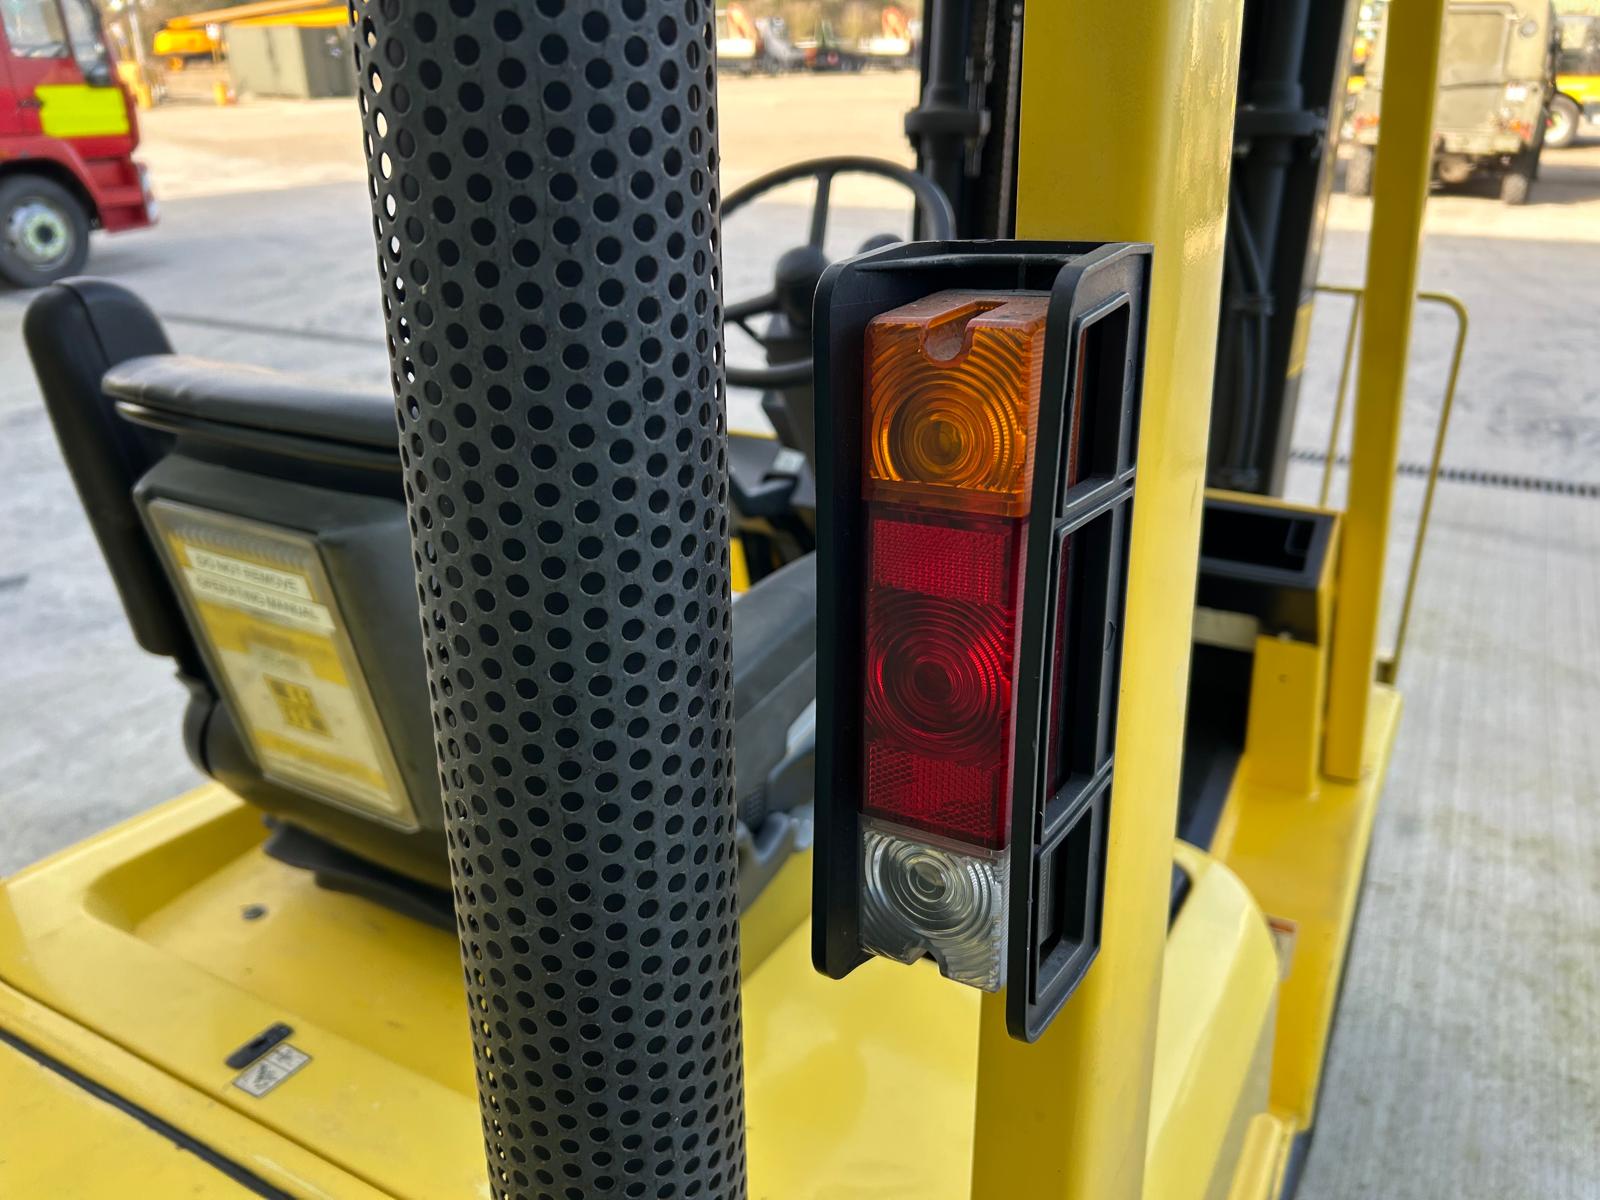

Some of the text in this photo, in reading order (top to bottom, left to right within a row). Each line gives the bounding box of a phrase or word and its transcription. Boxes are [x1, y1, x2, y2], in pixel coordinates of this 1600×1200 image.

[195, 554, 298, 591] DO NOT REMOVE
[197, 576, 319, 619] OPERATING MANUAL
